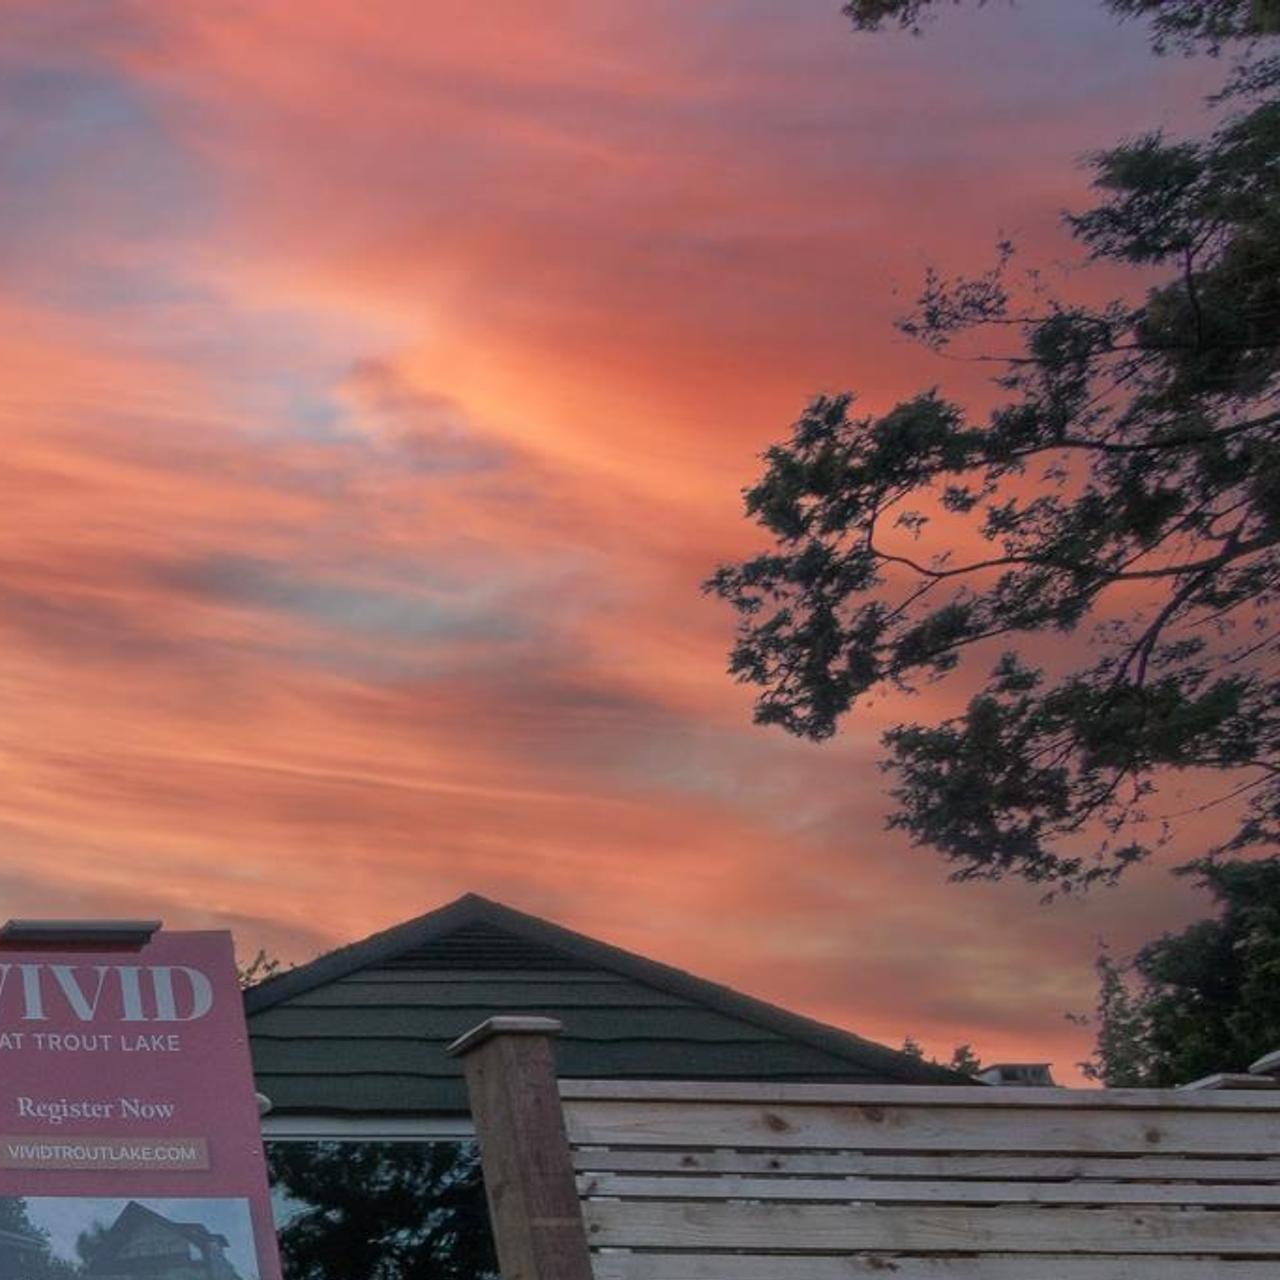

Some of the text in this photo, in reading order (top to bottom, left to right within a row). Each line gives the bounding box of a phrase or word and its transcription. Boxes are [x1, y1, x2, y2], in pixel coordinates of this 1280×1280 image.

[32, 1034, 113, 1051] TROUT
[120, 1035, 181, 1052] LAKE
[17, 1096, 175, 1125] Register Now
[7, 1144, 197, 1161] VIVIDTROUTLAKE.COM
